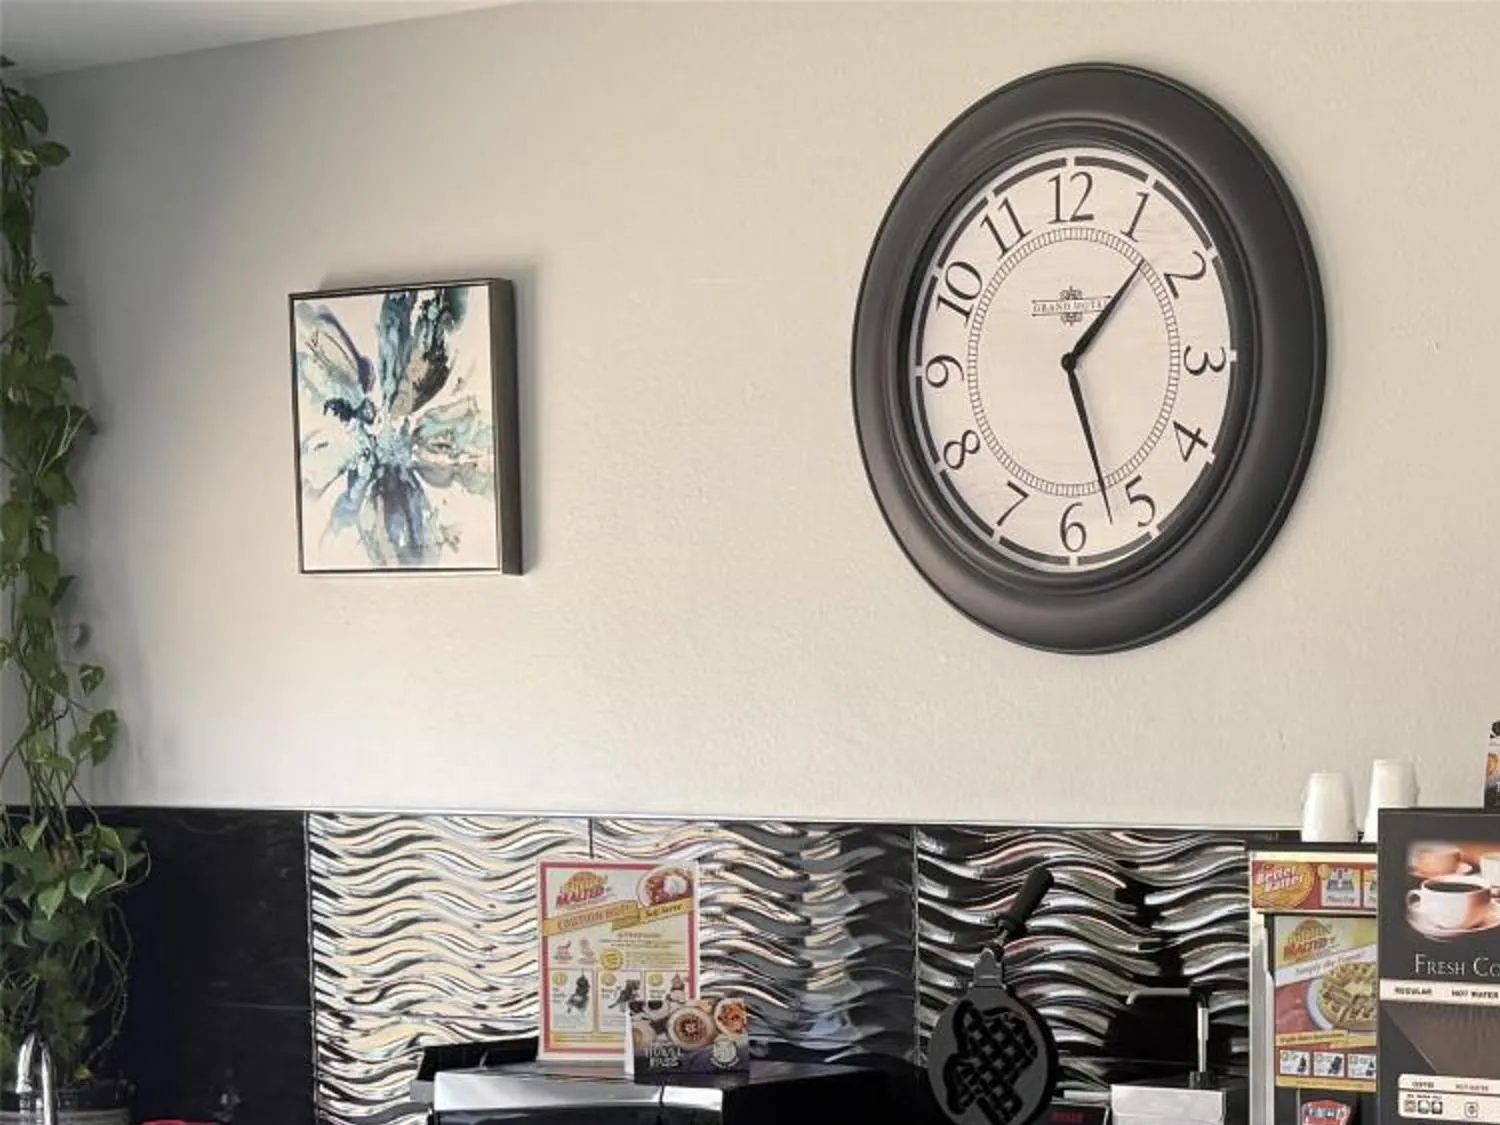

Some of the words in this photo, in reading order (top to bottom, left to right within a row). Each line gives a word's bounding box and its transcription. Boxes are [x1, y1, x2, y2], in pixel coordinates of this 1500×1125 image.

[1047, 171, 1095, 224] 12
[1120, 191, 1150, 242] 1
[979, 197, 1032, 260] 11
[935, 260, 985, 327] 10
[1164, 250, 1207, 298] 2
[925, 353, 964, 389] 9
[1183, 344, 1227, 377] 3
[942, 428, 981, 471] 8
[1172, 417, 1210, 463] 4
[996, 480, 1030, 529] 7
[1124, 475, 1156, 528] 5
[1059, 502, 1087, 553] 6
